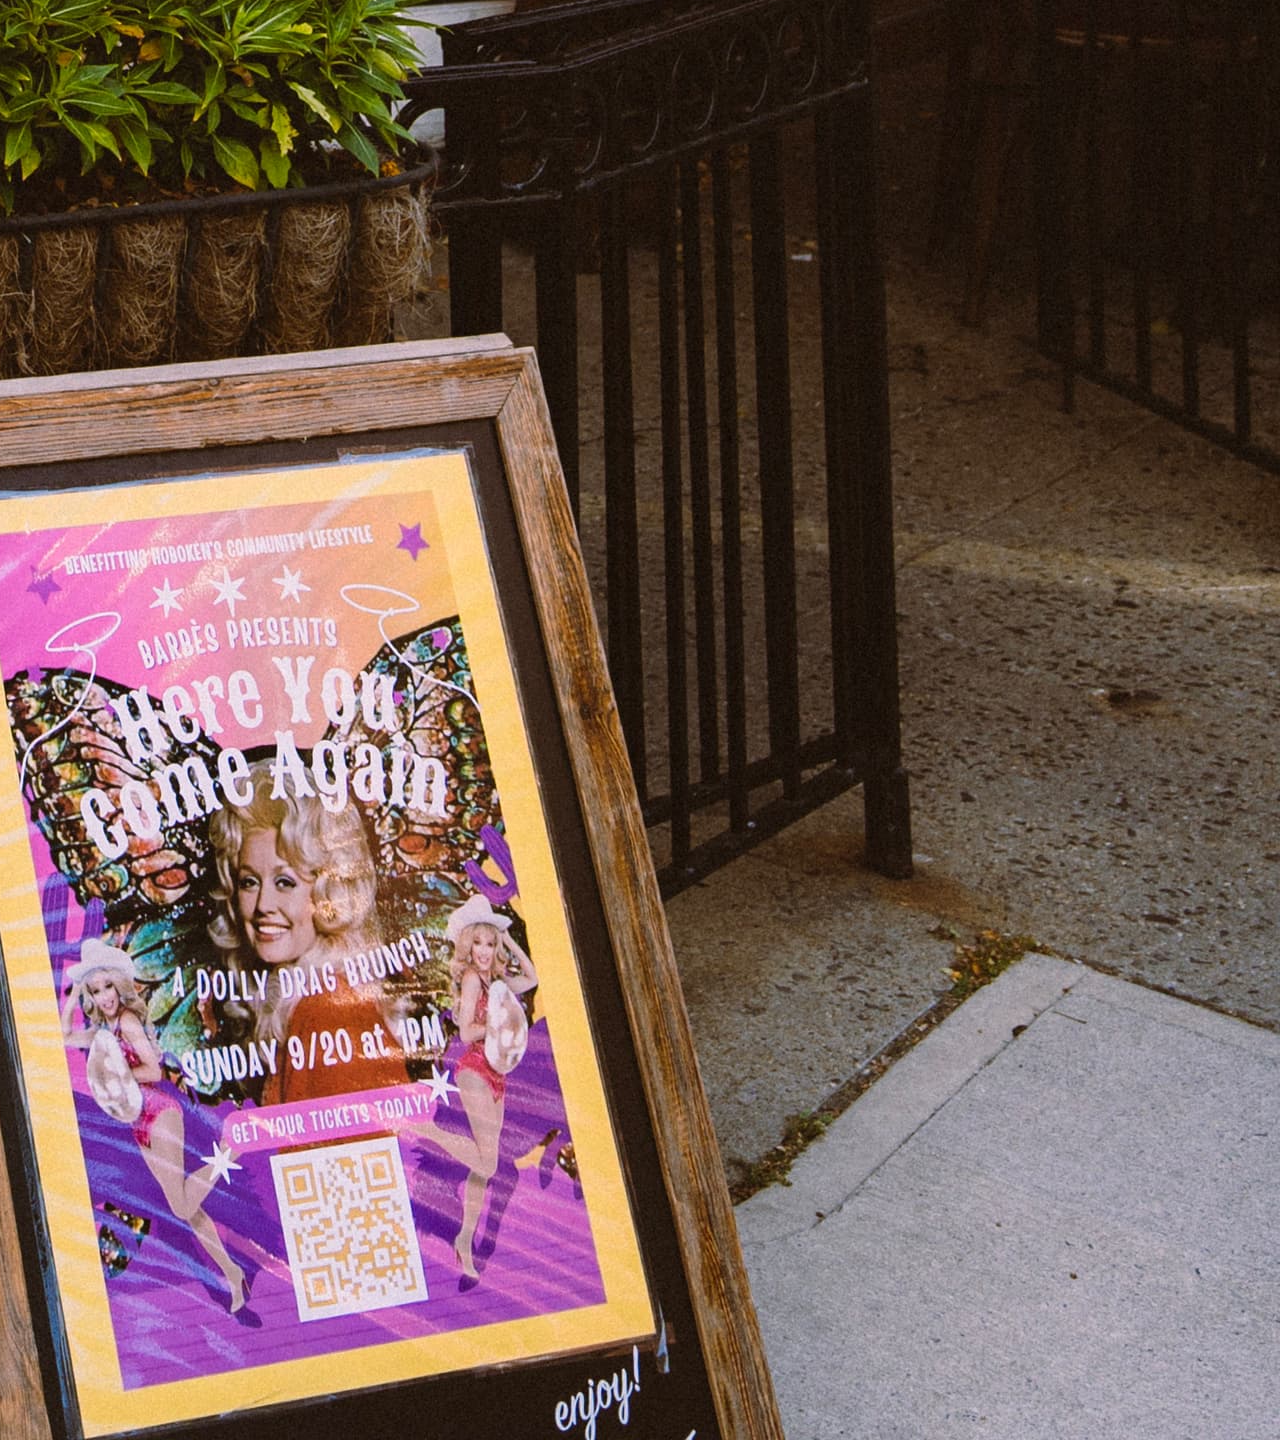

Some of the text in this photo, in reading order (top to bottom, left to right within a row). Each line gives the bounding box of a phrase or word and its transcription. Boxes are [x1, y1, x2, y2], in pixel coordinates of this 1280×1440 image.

[64, 524, 374, 575] BENEFITTING HOBOKEN'S COMMUNITY LIFESTYLE
[137, 616, 338, 670] BARBÈS PRESENTS
[109, 655, 398, 766] Here You
[79, 730, 449, 859] Come Again
[171, 931, 432, 1002] A DOLLY DRAG BRUNCH
[181, 1014, 448, 1087] SUNDAY 9/20 at 1PM
[231, 1093, 431, 1145] GET YOUR TICKETS TODAY!
[554, 1344, 641, 1440] enjoy!
